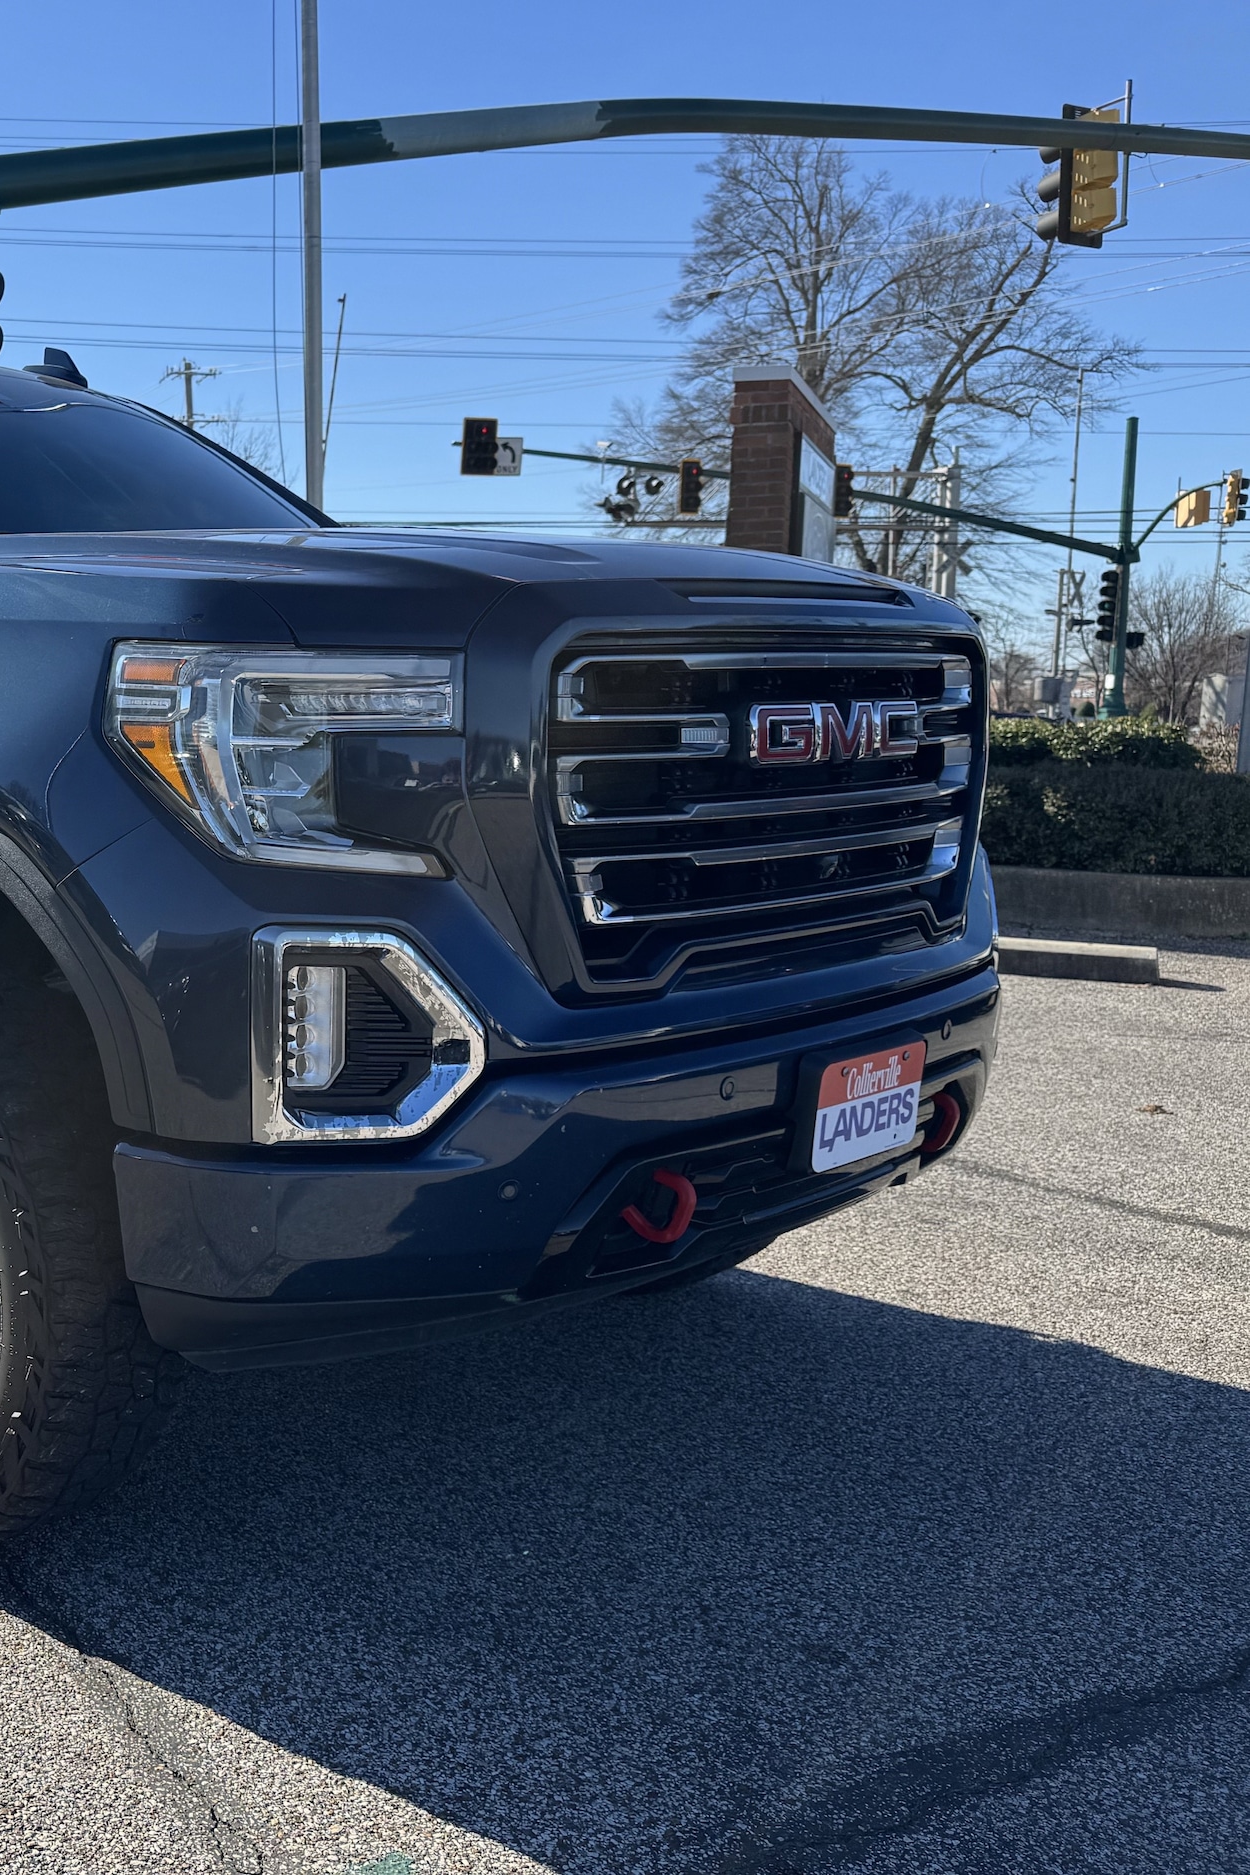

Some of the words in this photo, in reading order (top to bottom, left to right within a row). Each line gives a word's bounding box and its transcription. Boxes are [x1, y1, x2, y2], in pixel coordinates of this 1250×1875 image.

[750, 701, 918, 764] GMC
[846, 1055, 902, 1100] Collierville
[818, 1087, 915, 1153] LANDERS
